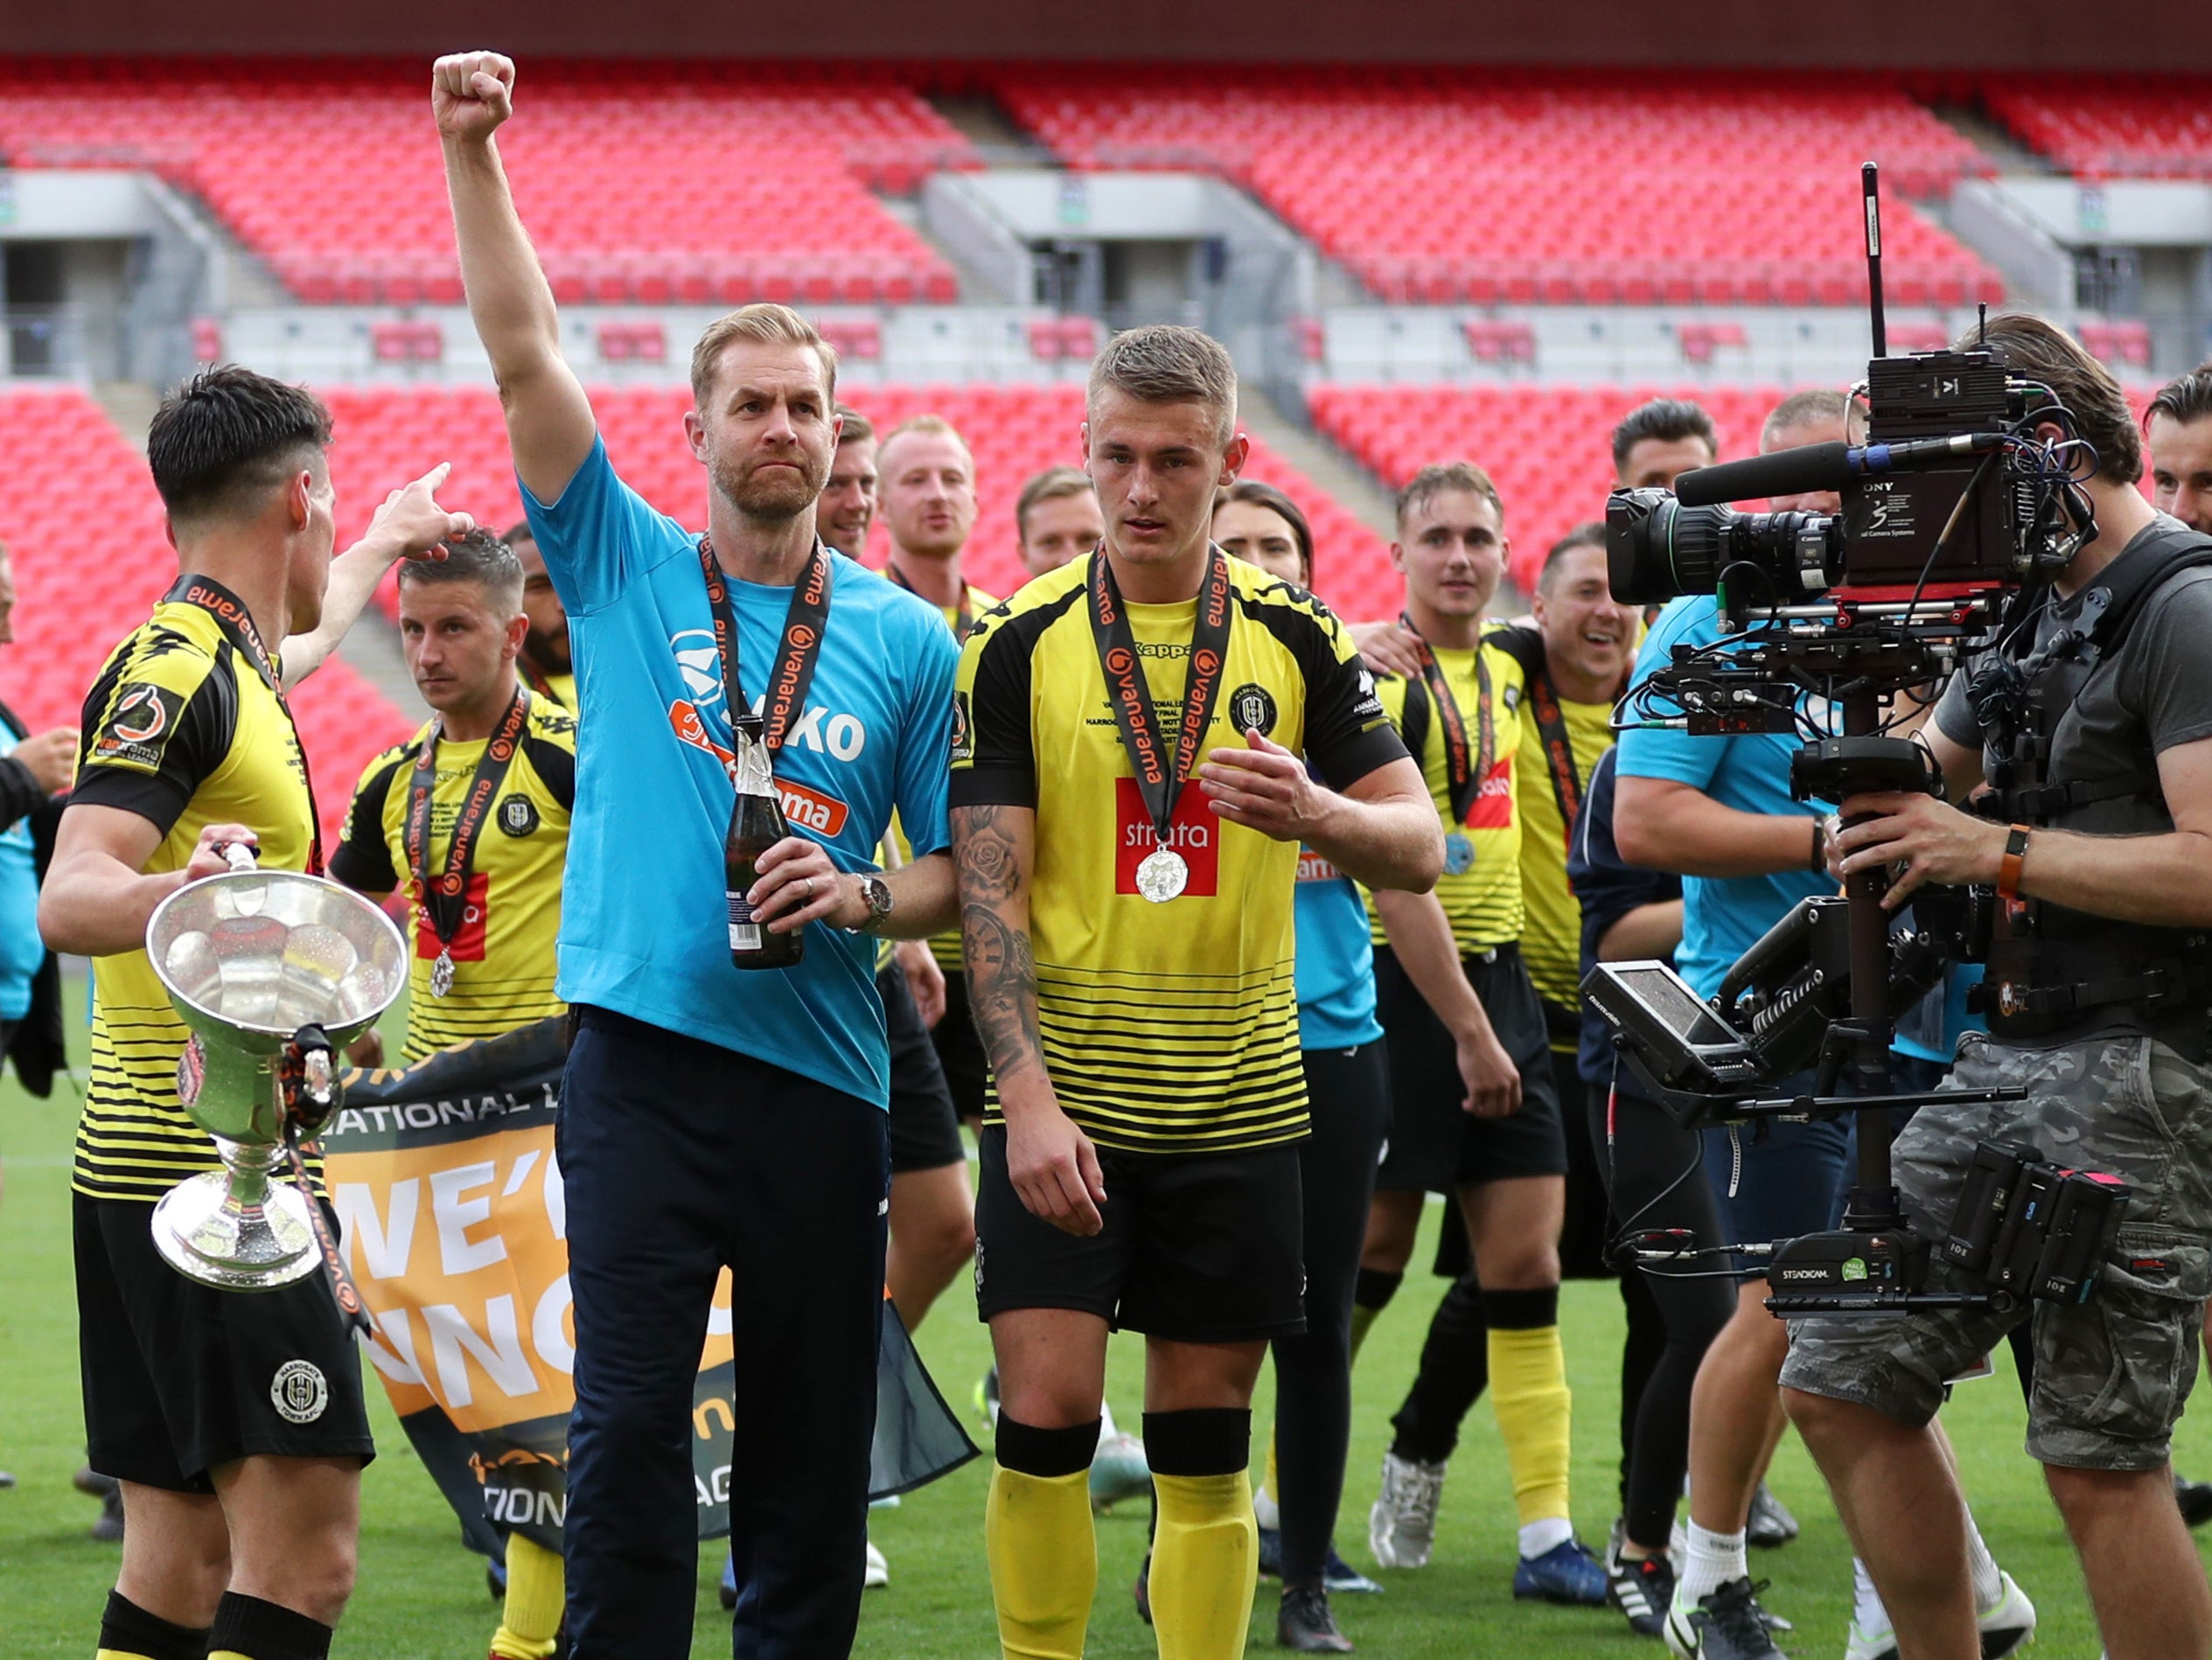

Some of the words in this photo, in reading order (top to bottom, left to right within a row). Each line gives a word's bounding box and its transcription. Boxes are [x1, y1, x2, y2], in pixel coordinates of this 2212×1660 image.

[1863, 482, 1894, 492] ONY
[1891, 529, 1915, 538] Systems
[767, 651, 806, 750] vanarama
[1118, 673, 1162, 784] vanarama
[1176, 678, 1211, 784] vanarama
[450, 779, 493, 871] vanarama
[328, 1093, 531, 1135] ATIONAL
[1782, 1269, 1829, 1280] STEADICAM
